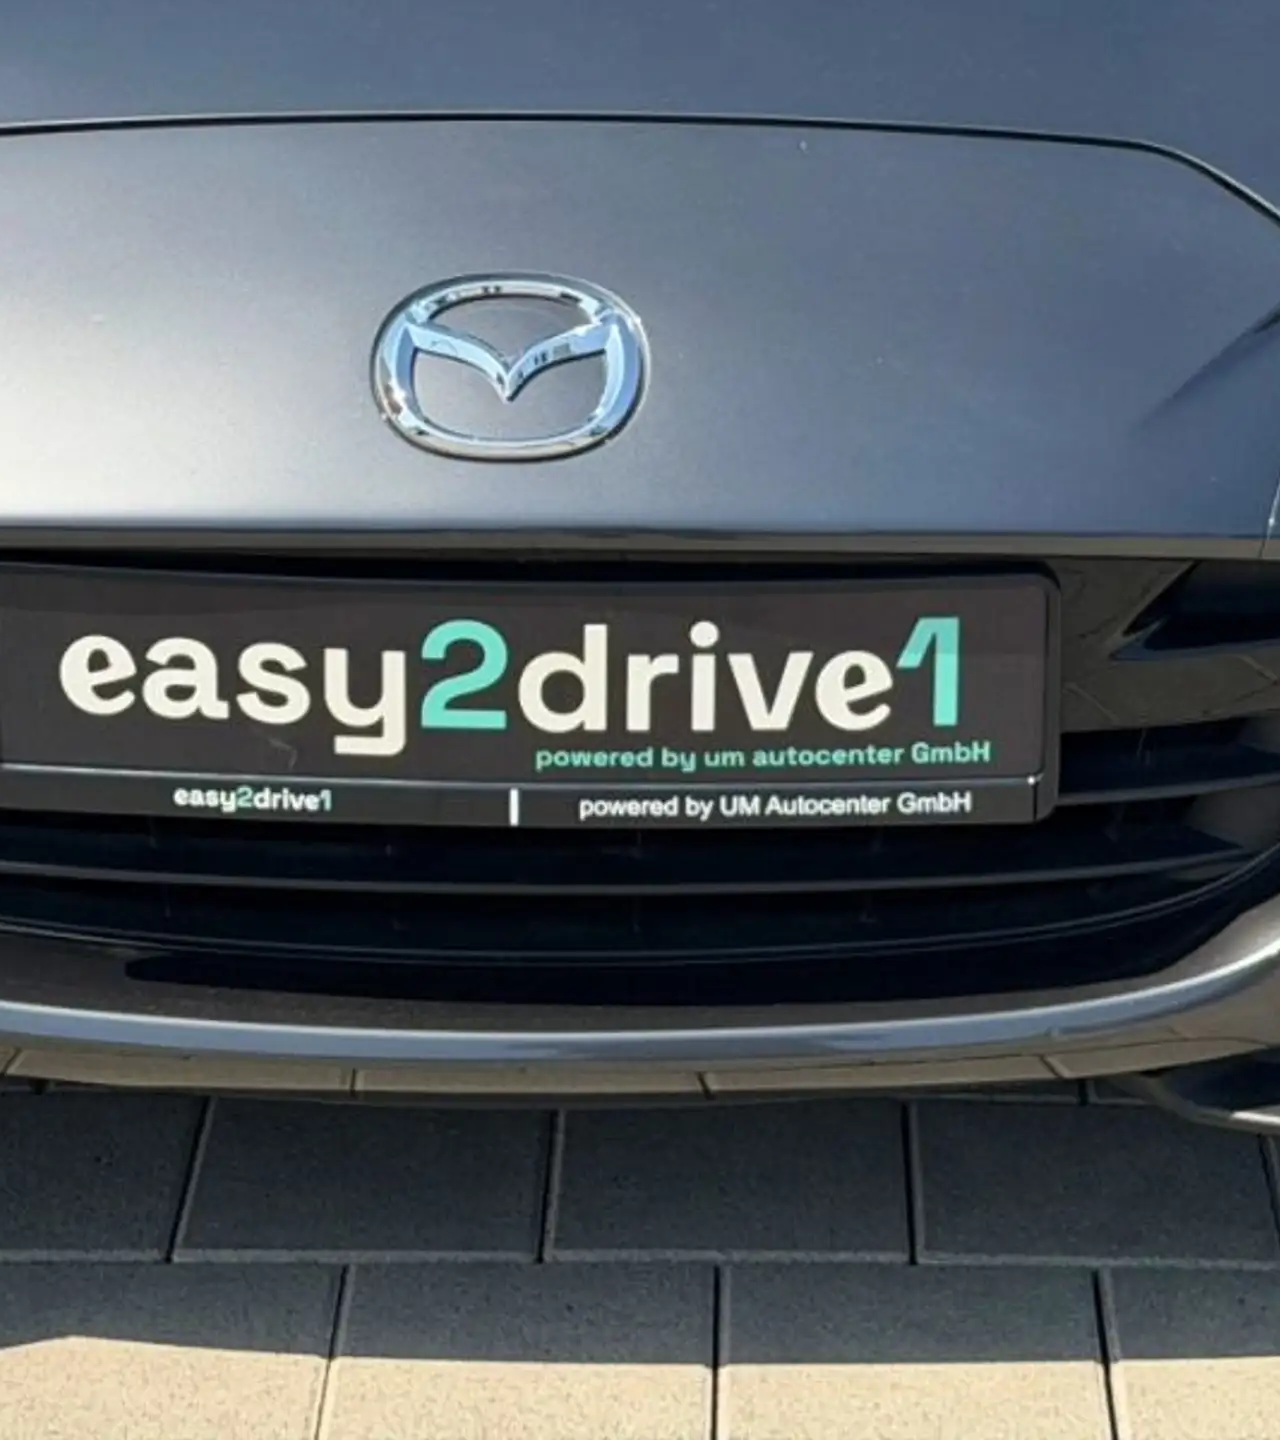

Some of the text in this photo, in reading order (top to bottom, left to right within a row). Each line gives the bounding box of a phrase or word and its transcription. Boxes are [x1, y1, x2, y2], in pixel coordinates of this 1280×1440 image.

[59, 617, 960, 756] easy2drive1
[535, 741, 991, 773] powered by um autocenter GmbH
[173, 785, 332, 813] easy2drive1
[579, 791, 972, 822] powered by UM Autocenter GmbH
